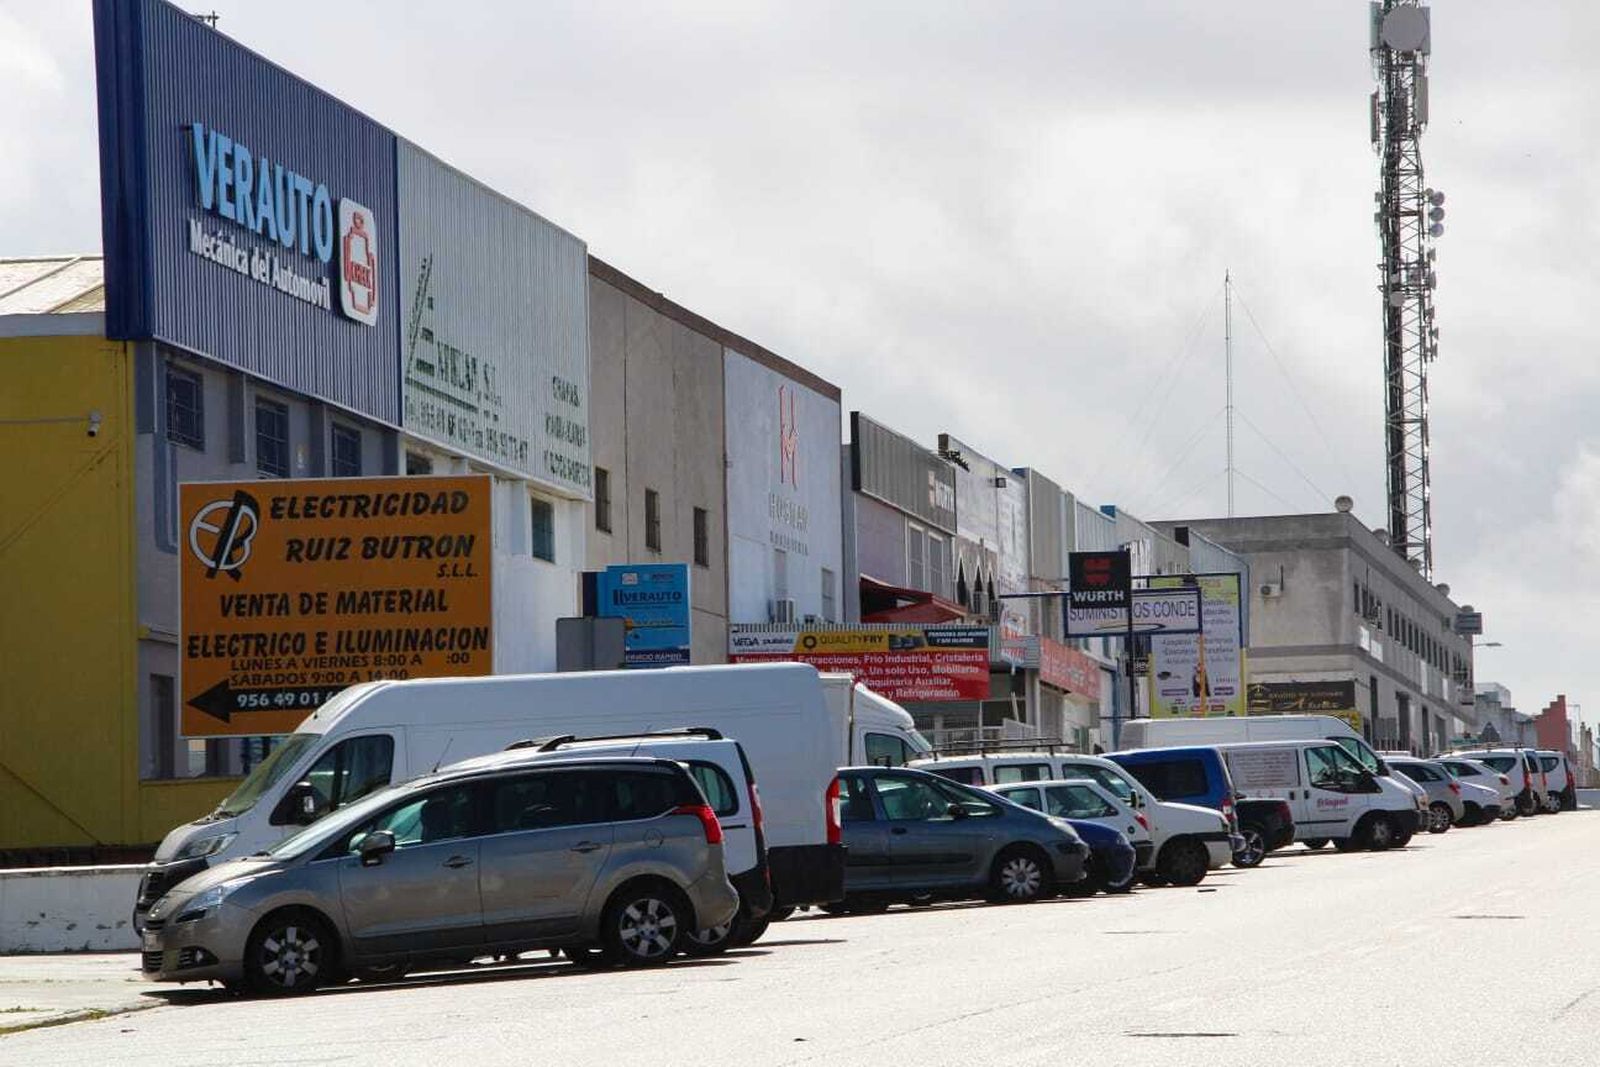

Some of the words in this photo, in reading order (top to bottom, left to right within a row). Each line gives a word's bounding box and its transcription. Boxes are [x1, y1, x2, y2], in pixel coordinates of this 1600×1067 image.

[193, 123, 333, 263] VERAUTO
[190, 218, 249, 275] Mecánica
[251, 246, 270, 284] del
[270, 490, 469, 519] ELECTRICIDAD
[286, 537, 351, 563] RUIZ
[361, 534, 475, 560] BUTRON
[436, 563, 478, 578] S.L.L.
[220, 593, 290, 617] VENTA
[299, 592, 328, 615] DE
[335, 588, 448, 614] MATERIAL
[623, 591, 682, 601] VERAUTO
[1070, 602, 1151, 622] SUMINISTOS
[1153, 600, 1196, 618] CONDE
[187, 632, 306, 658] ELECTRICO
[315, 631, 328, 655] E
[336, 627, 489, 653] ILUMINACION
[820, 633, 883, 645] QUALITYFRY
[231, 659, 282, 671] LUNES
[286, 659, 298, 670] A
[303, 655, 369, 669] VIERNES
[373, 654, 407, 667] 8:00
[410, 654, 422, 665] A
[798, 655, 861, 665] Extracciones,
[885, 654, 932, 664] Industrial,
[869, 666, 883, 675] Un
[885, 665, 906, 674] solo
[908, 665, 929, 675] Uso,
[932, 664, 979, 674] Mobiliario
[230, 673, 307, 687] SABADOS
[311, 672, 345, 683] 9:00
[348, 671, 360, 682] A
[914, 677, 954, 687] Auxiliar,
[237, 693, 269, 708] 956
[274, 693, 295, 706] 49
[300, 691, 319, 705] 01
[888, 690, 894, 699] y
